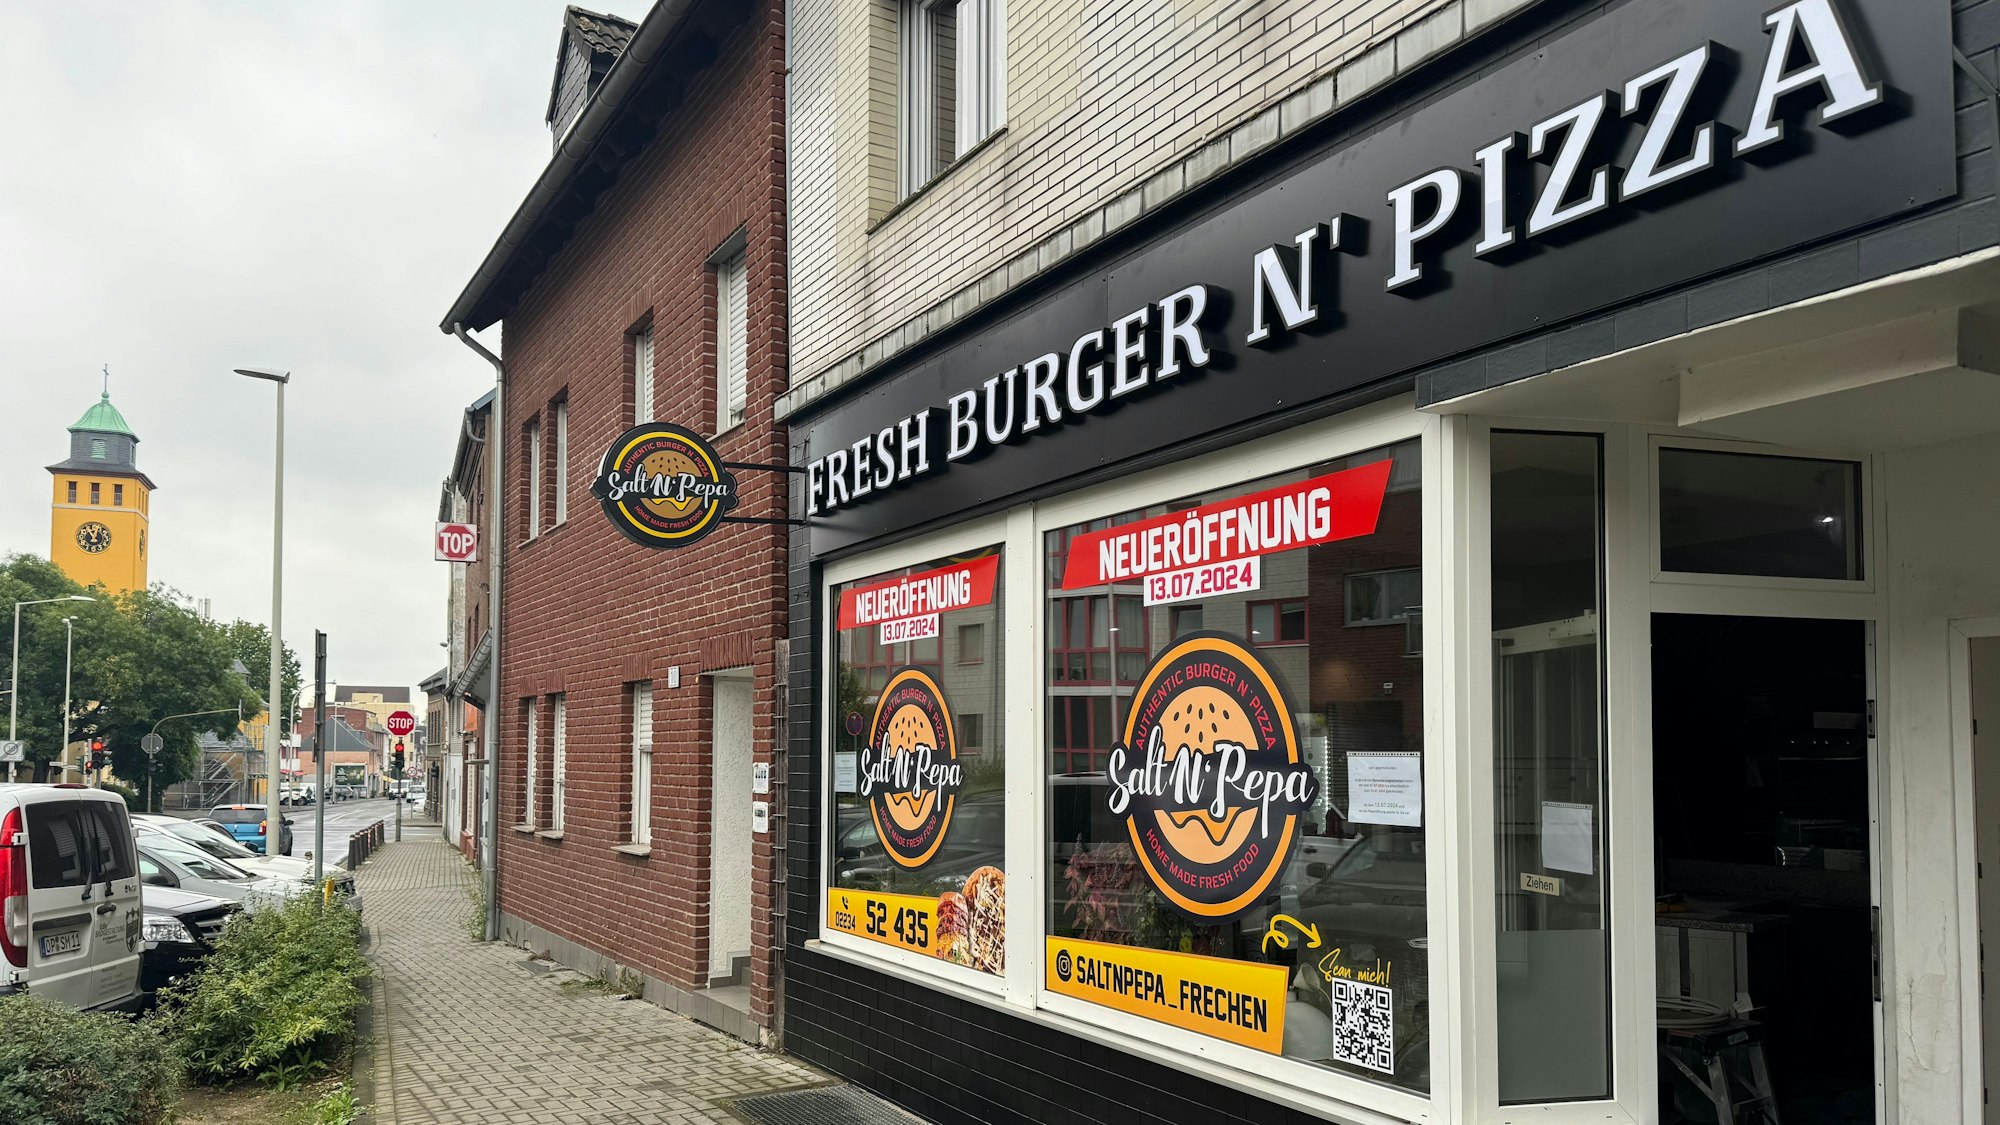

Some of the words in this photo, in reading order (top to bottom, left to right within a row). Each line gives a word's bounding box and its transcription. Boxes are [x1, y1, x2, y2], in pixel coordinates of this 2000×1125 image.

[807, 408, 931, 516] FRESH
[947, 283, 1209, 461] BURGER
[1246, 216, 1343, 344] N'
[1386, 0, 1881, 290] PIZZA
[624, 442, 655, 474] AUTHENTIC
[656, 441, 687, 453] BURGER
[695, 456, 710, 477] PIZZA
[608, 463, 650, 500] Salt
[676, 472, 731, 509] Pepa
[634, 505, 650, 522] HOME
[650, 519, 669, 528] MADE
[669, 520, 690, 529] FRESH
[689, 509, 703, 524] FOOD
[1099, 487, 1331, 580] NEUERÖFFNUNG
[440, 532, 475, 554] TOP
[856, 569, 971, 624] NEUERÖFFNUNG
[1149, 563, 1252, 601] 13.07.2024
[884, 617, 935, 642] 13.07.2024
[389, 717, 413, 729] STOP
[875, 692, 901, 750] AUTHENTIC
[901, 688, 927, 704] BURGER
[932, 712, 946, 750] PIZZA
[1135, 671, 1183, 750] AUTHENTIC
[1185, 663, 1236, 684] BURGER
[1249, 695, 1277, 750] PIZZA
[860, 732, 893, 796] Salt
[913, 745, 963, 812] Pepa
[1109, 725, 1167, 814] Salt
[1210, 744, 1314, 839] Pepa
[879, 806, 892, 834] HOME
[892, 829, 906, 847] MADE
[906, 834, 924, 849] FRESH
[923, 815, 937, 839] FOOD
[1146, 829, 1169, 867] HOME
[1169, 863, 1196, 888] MADE
[1199, 872, 1233, 889] FRESH
[1234, 843, 1259, 878] FOOD
[1526, 875, 1554, 892] Ziehen
[46, 938, 56, 953] OP
[835, 911, 856, 931] 02234
[866, 900, 887, 937] 52
[893, 907, 928, 948] 435
[1318, 947, 1351, 982] Scan
[1358, 958, 1391, 988] mich!
[1076, 955, 1267, 1033] SALTNPEPA_FRECHEN
